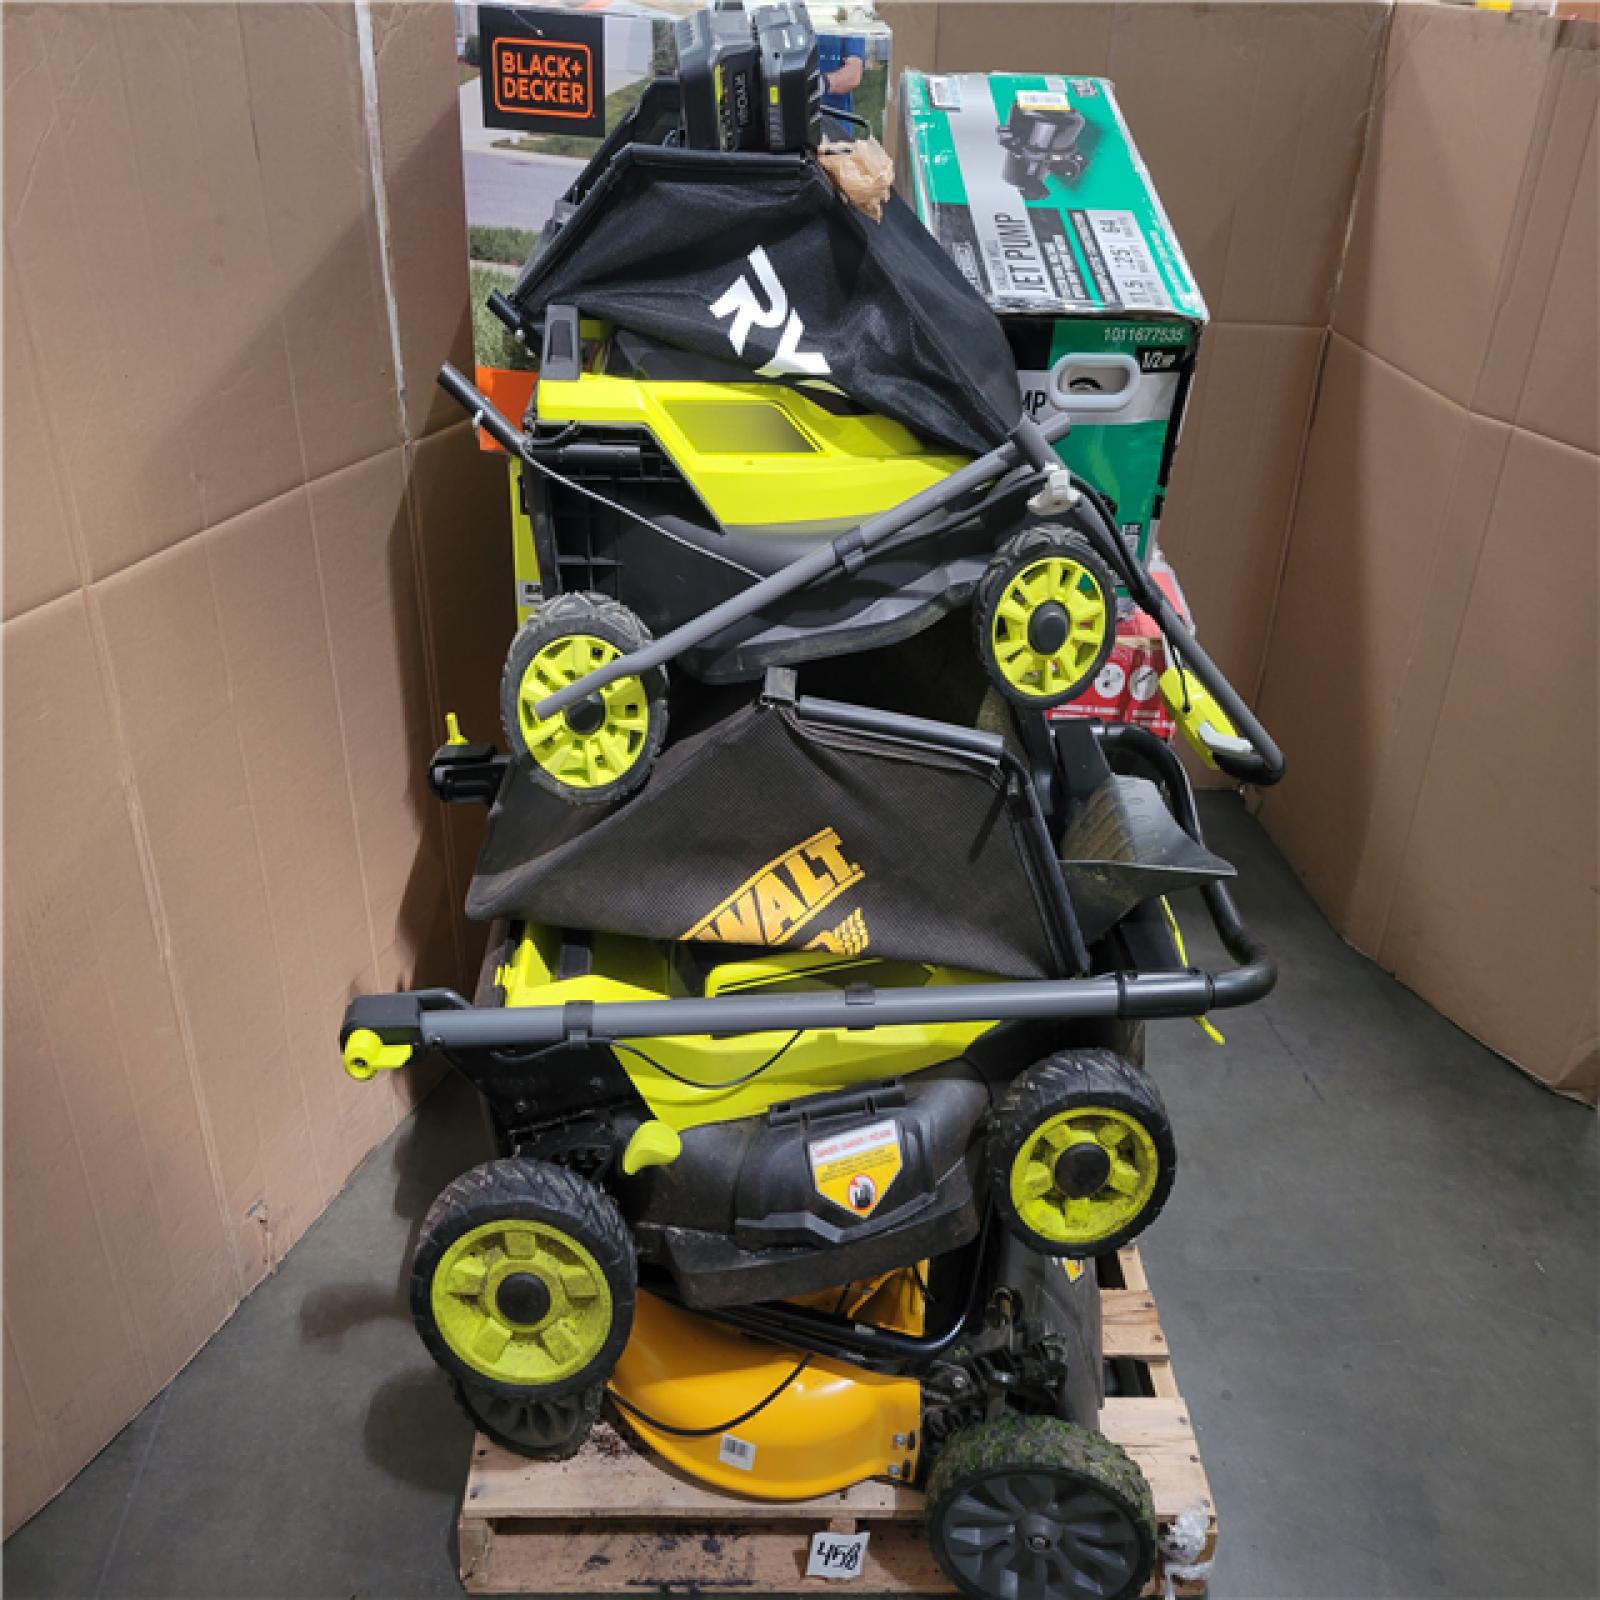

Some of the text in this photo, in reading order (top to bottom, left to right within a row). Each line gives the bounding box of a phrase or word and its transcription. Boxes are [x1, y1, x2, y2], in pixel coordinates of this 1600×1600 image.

[501, 51, 584, 80] BLACK+
[502, 76, 586, 106] DECKER
[994, 212, 1035, 260] PUMP
[1009, 264, 1047, 292] JET
[708, 244, 836, 382] RY
